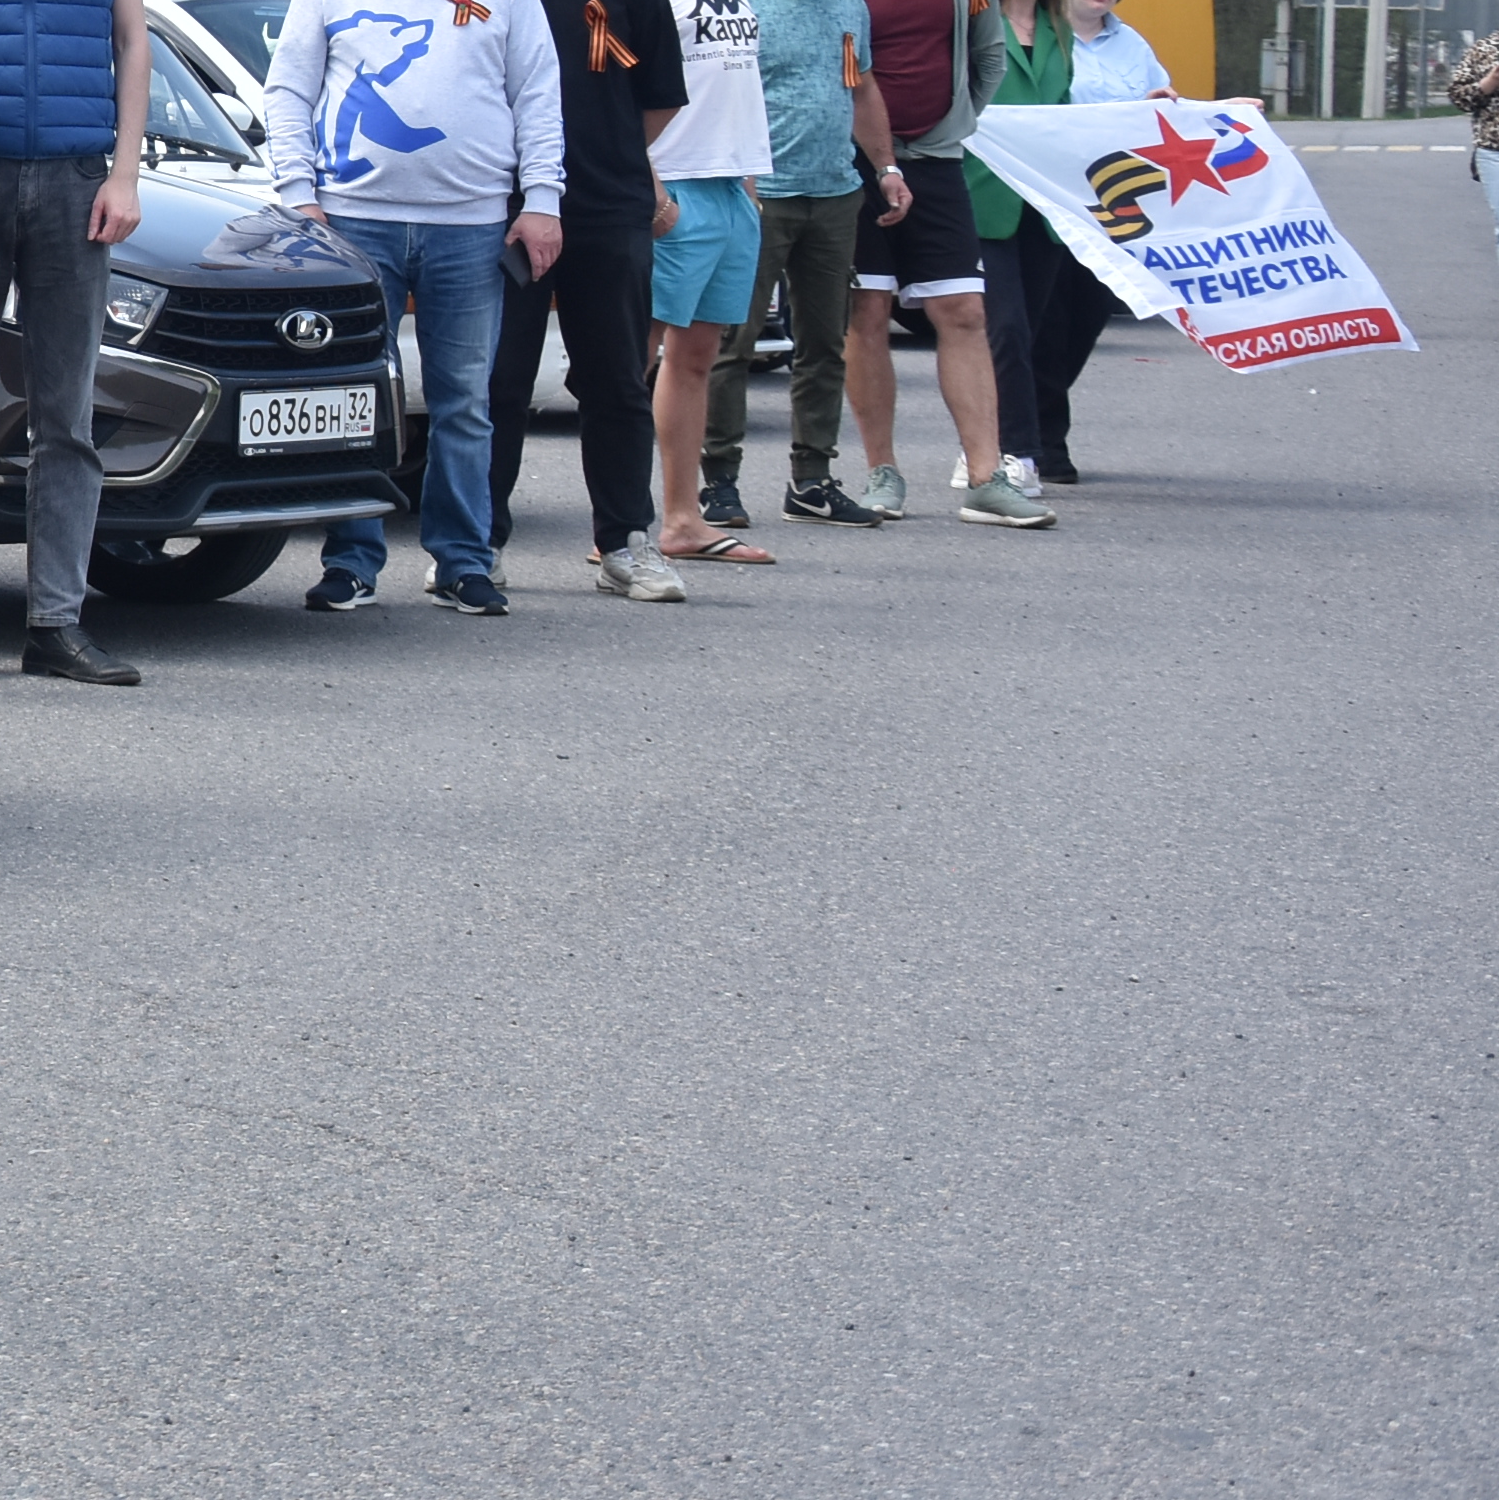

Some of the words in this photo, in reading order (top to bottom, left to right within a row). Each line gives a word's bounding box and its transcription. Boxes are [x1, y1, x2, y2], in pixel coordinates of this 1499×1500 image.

[693, 16, 759, 46] Kappa
[1124, 219, 1336, 271] АЩИТНИКИ
[1171, 254, 1348, 304] ТЕЧЕСТВА
[1210, 335, 1288, 364] СКАЯ
[1290, 318, 1381, 350] ОБЛАСТЬ
[249, 397, 342, 437] О836ВН
[348, 392, 369, 421] 32
[345, 422, 360, 433] RUS
